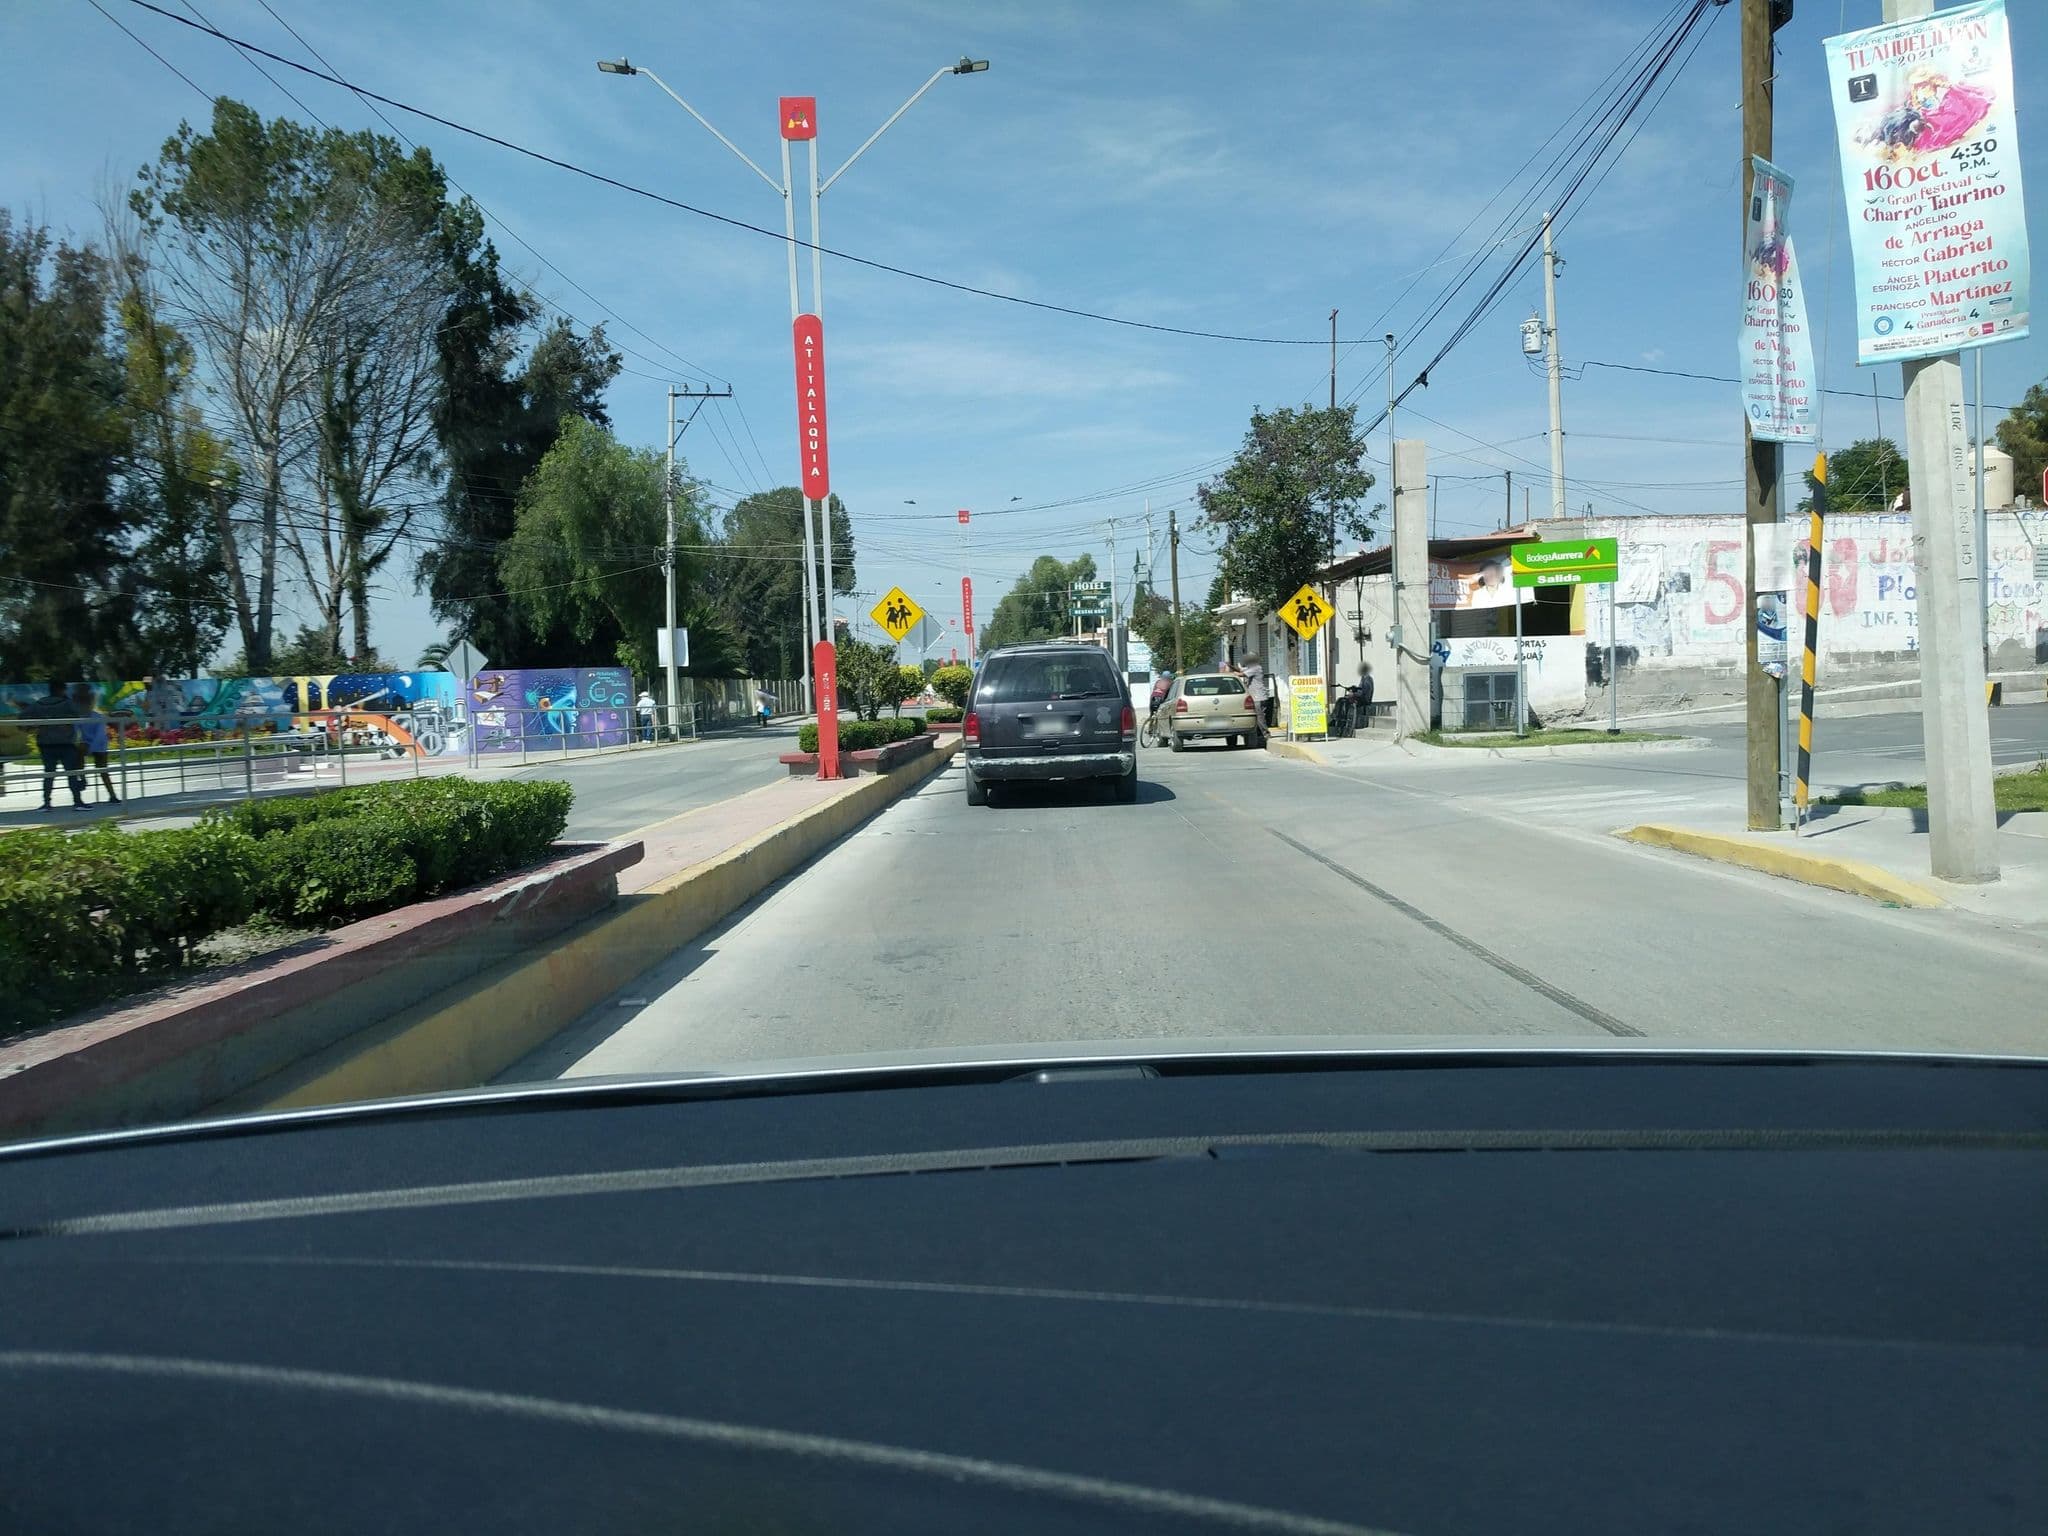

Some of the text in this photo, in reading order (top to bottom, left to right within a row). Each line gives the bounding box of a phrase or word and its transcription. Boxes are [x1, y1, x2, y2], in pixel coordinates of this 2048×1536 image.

[1897, 50, 1935, 67] 2021
[1950, 139, 1998, 160] 4:30
[1959, 157, 1991, 172] P.M.
[1887, 190, 1917, 206] Gran
[1905, 211, 1957, 232] ANGELINO
[1885, 219, 1984, 250] de Arriaga
[1923, 236, 1993, 263] Gabriel
[1924, 259, 2009, 285] Platerito
[1870, 281, 2013, 312] FRANCISCO Martínez
[1872, 282, 1921, 293] ESPINOZA
[1904, 321, 1914, 331] 4
[1969, 308, 1980, 319] 4
[804, 335, 820, 476] ATITALAQUIA
[1074, 582, 1106, 590] HOTEL
[1536, 573, 1581, 584] Salida
[1462, 638, 1509, 662] ANTOJITOS
